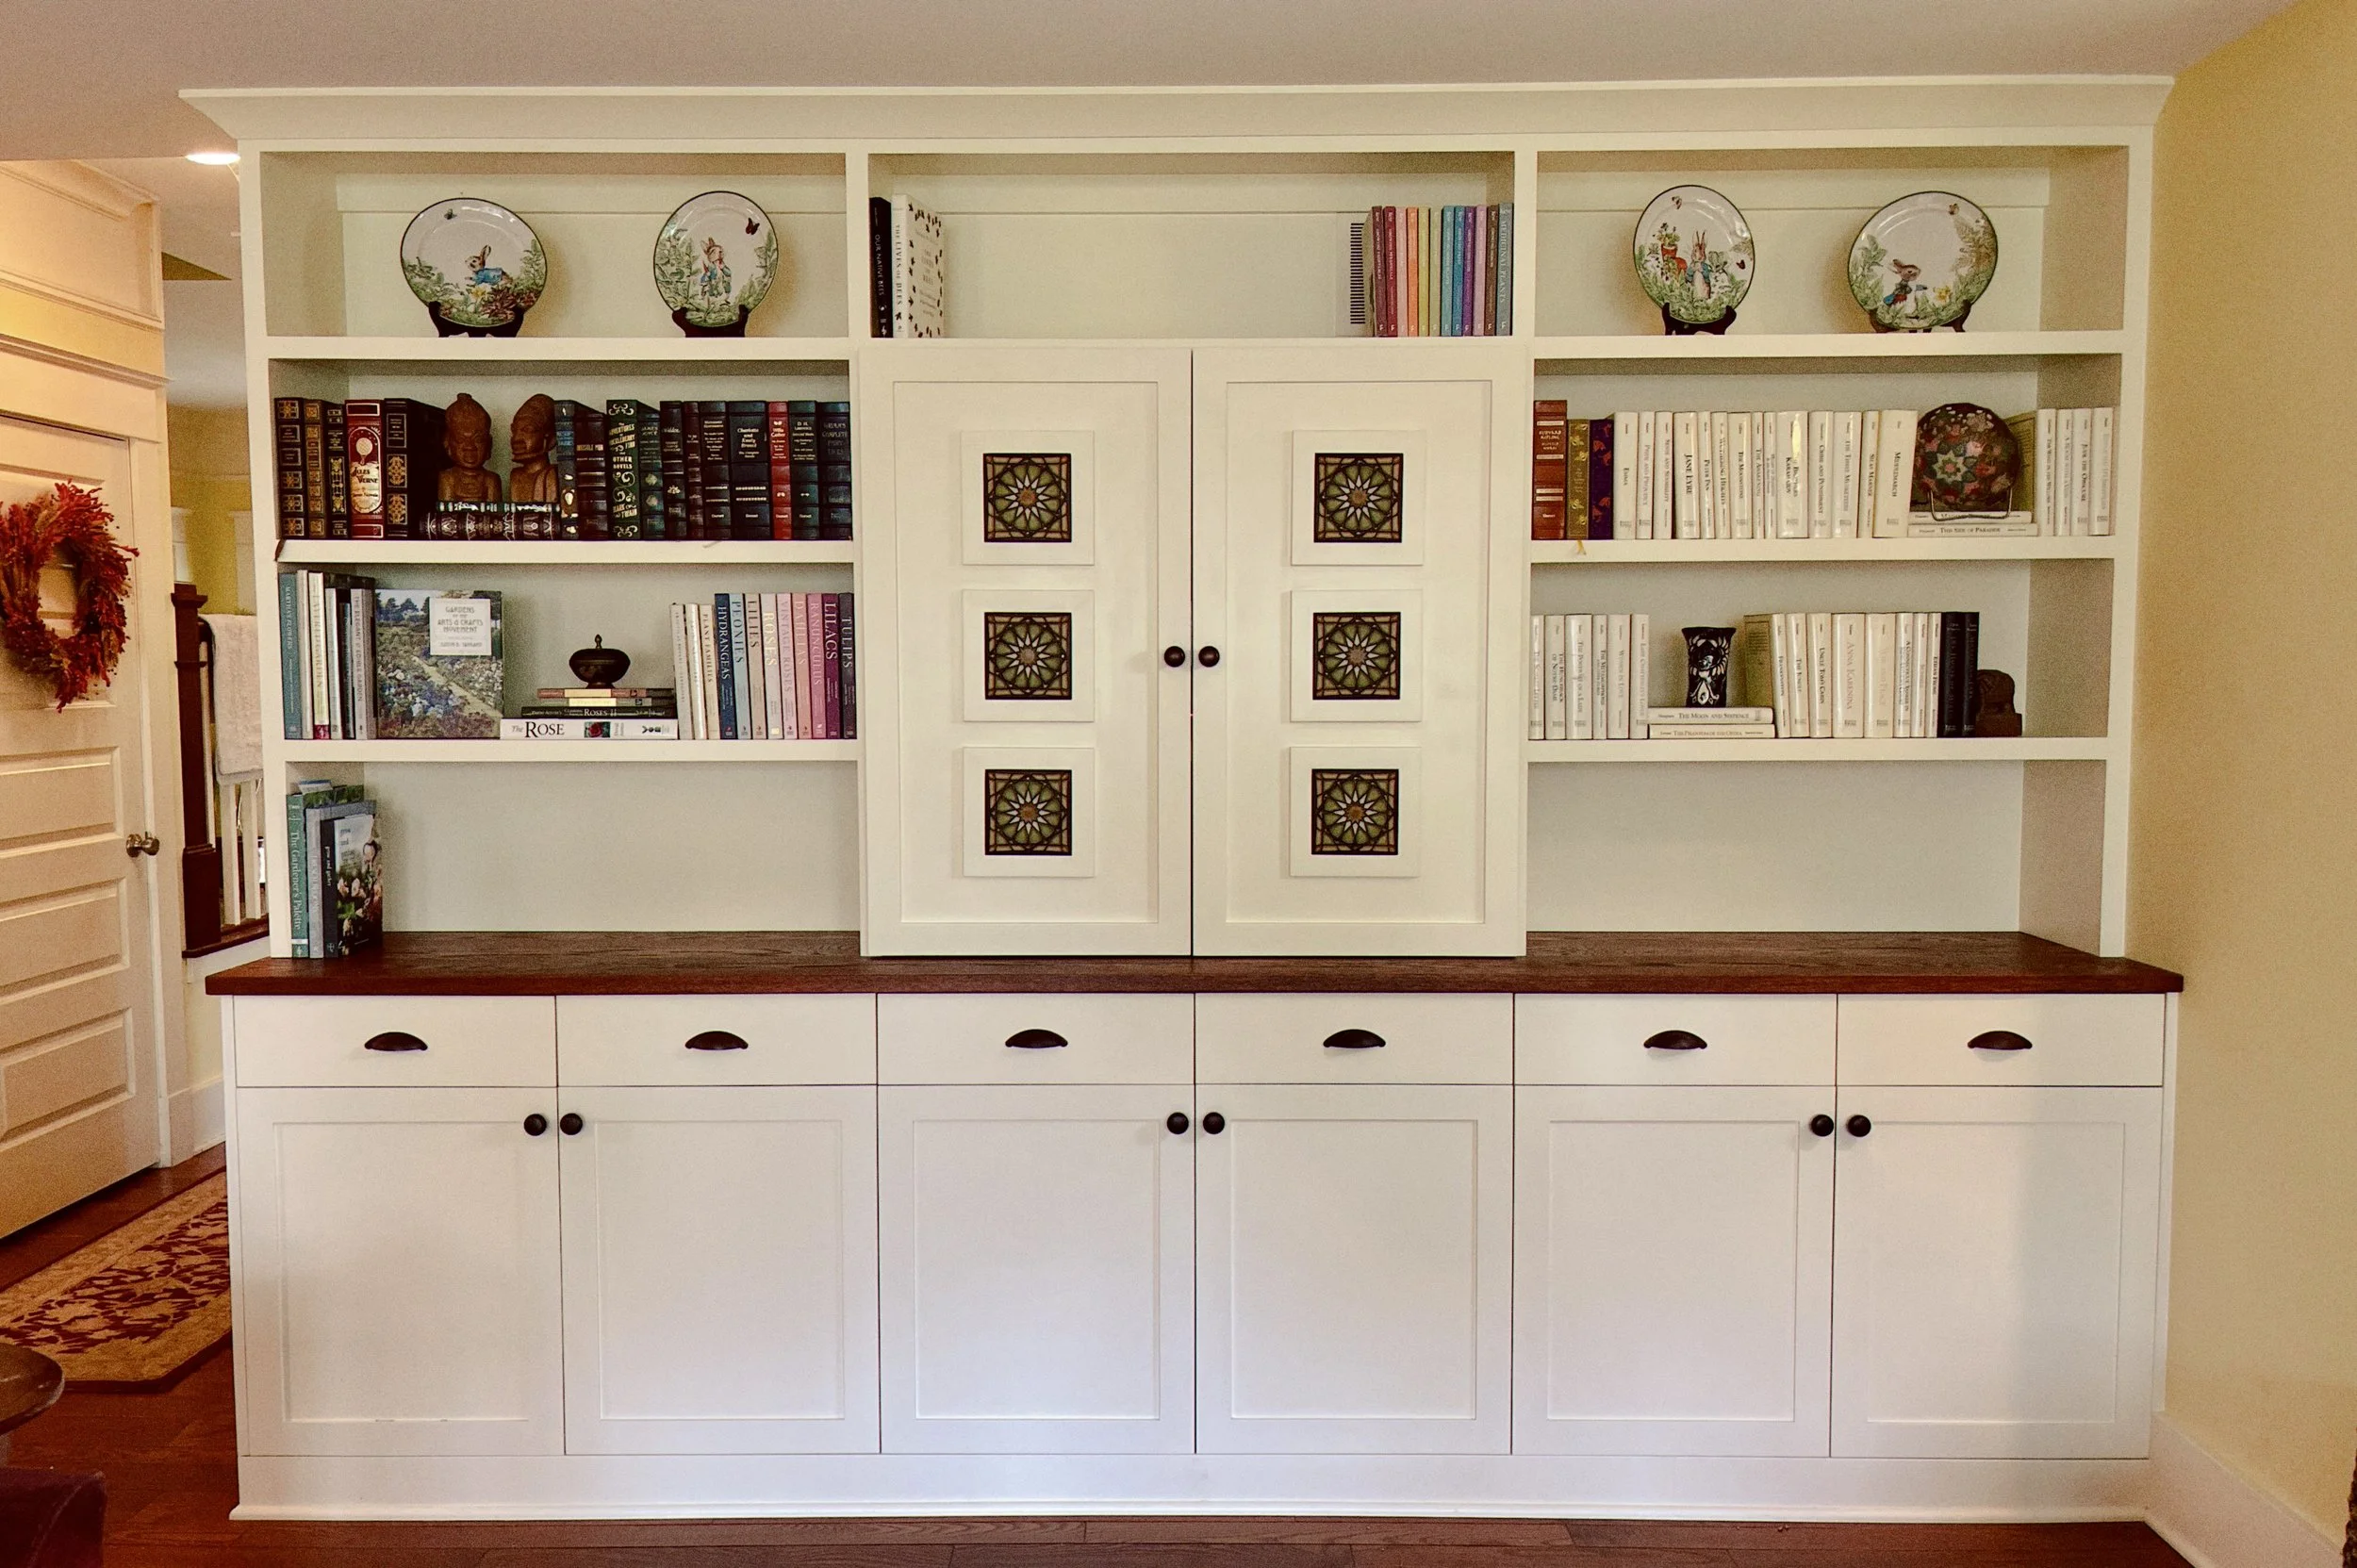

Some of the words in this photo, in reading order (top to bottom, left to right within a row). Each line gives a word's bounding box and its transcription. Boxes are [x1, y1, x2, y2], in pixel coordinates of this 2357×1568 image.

[895, 240, 903, 268] LIVES
[1499, 220, 1509, 271] MEDICINAL
[1498, 272, 1508, 304] PLANTS
[1683, 454, 1693, 474] JANE
[1755, 449, 1763, 461] THE
[1818, 444, 1826, 463] CRIME
[354, 467, 371, 476] JULES
[356, 475, 378, 484] VERNE
[1685, 474, 1694, 496] EYRE
[1867, 470, 1875, 497] MARNER
[1890, 452, 1902, 498] MIDDLEMARCH
[621, 508, 637, 520] TWAIN
[286, 619, 294, 650] FLOWERS
[732, 601, 746, 664] PEONIES
[747, 600, 761, 649] LILIES
[764, 612, 778, 667] ROSES
[780, 601, 791, 652] VINTAGE
[795, 600, 808, 666] DAHLIAS
[824, 602, 838, 660] LILACS
[717, 606, 731, 680] HYDRANGEAS
[810, 602, 823, 686] RANUNCULUS
[841, 616, 853, 668] TULIPS
[1846, 641, 1855, 667] ANNA
[315, 643, 324, 688] GARDEN
[355, 649, 364, 672] EDIBLE
[703, 644, 714, 684] FAMILIES
[783, 656, 794, 693] ROSES
[356, 674, 365, 702] GARDEN
[1617, 683, 1625, 699] LOVE
[1819, 685, 1827, 705] CABIN
[1845, 668, 1855, 711] KARENINA
[584, 708, 608, 717] ROSES
[512, 724, 524, 733] The
[525, 721, 566, 738] ROSE
[290, 830, 300, 849] The
[291, 850, 303, 898] Gardener's
[294, 900, 304, 931] Palette
